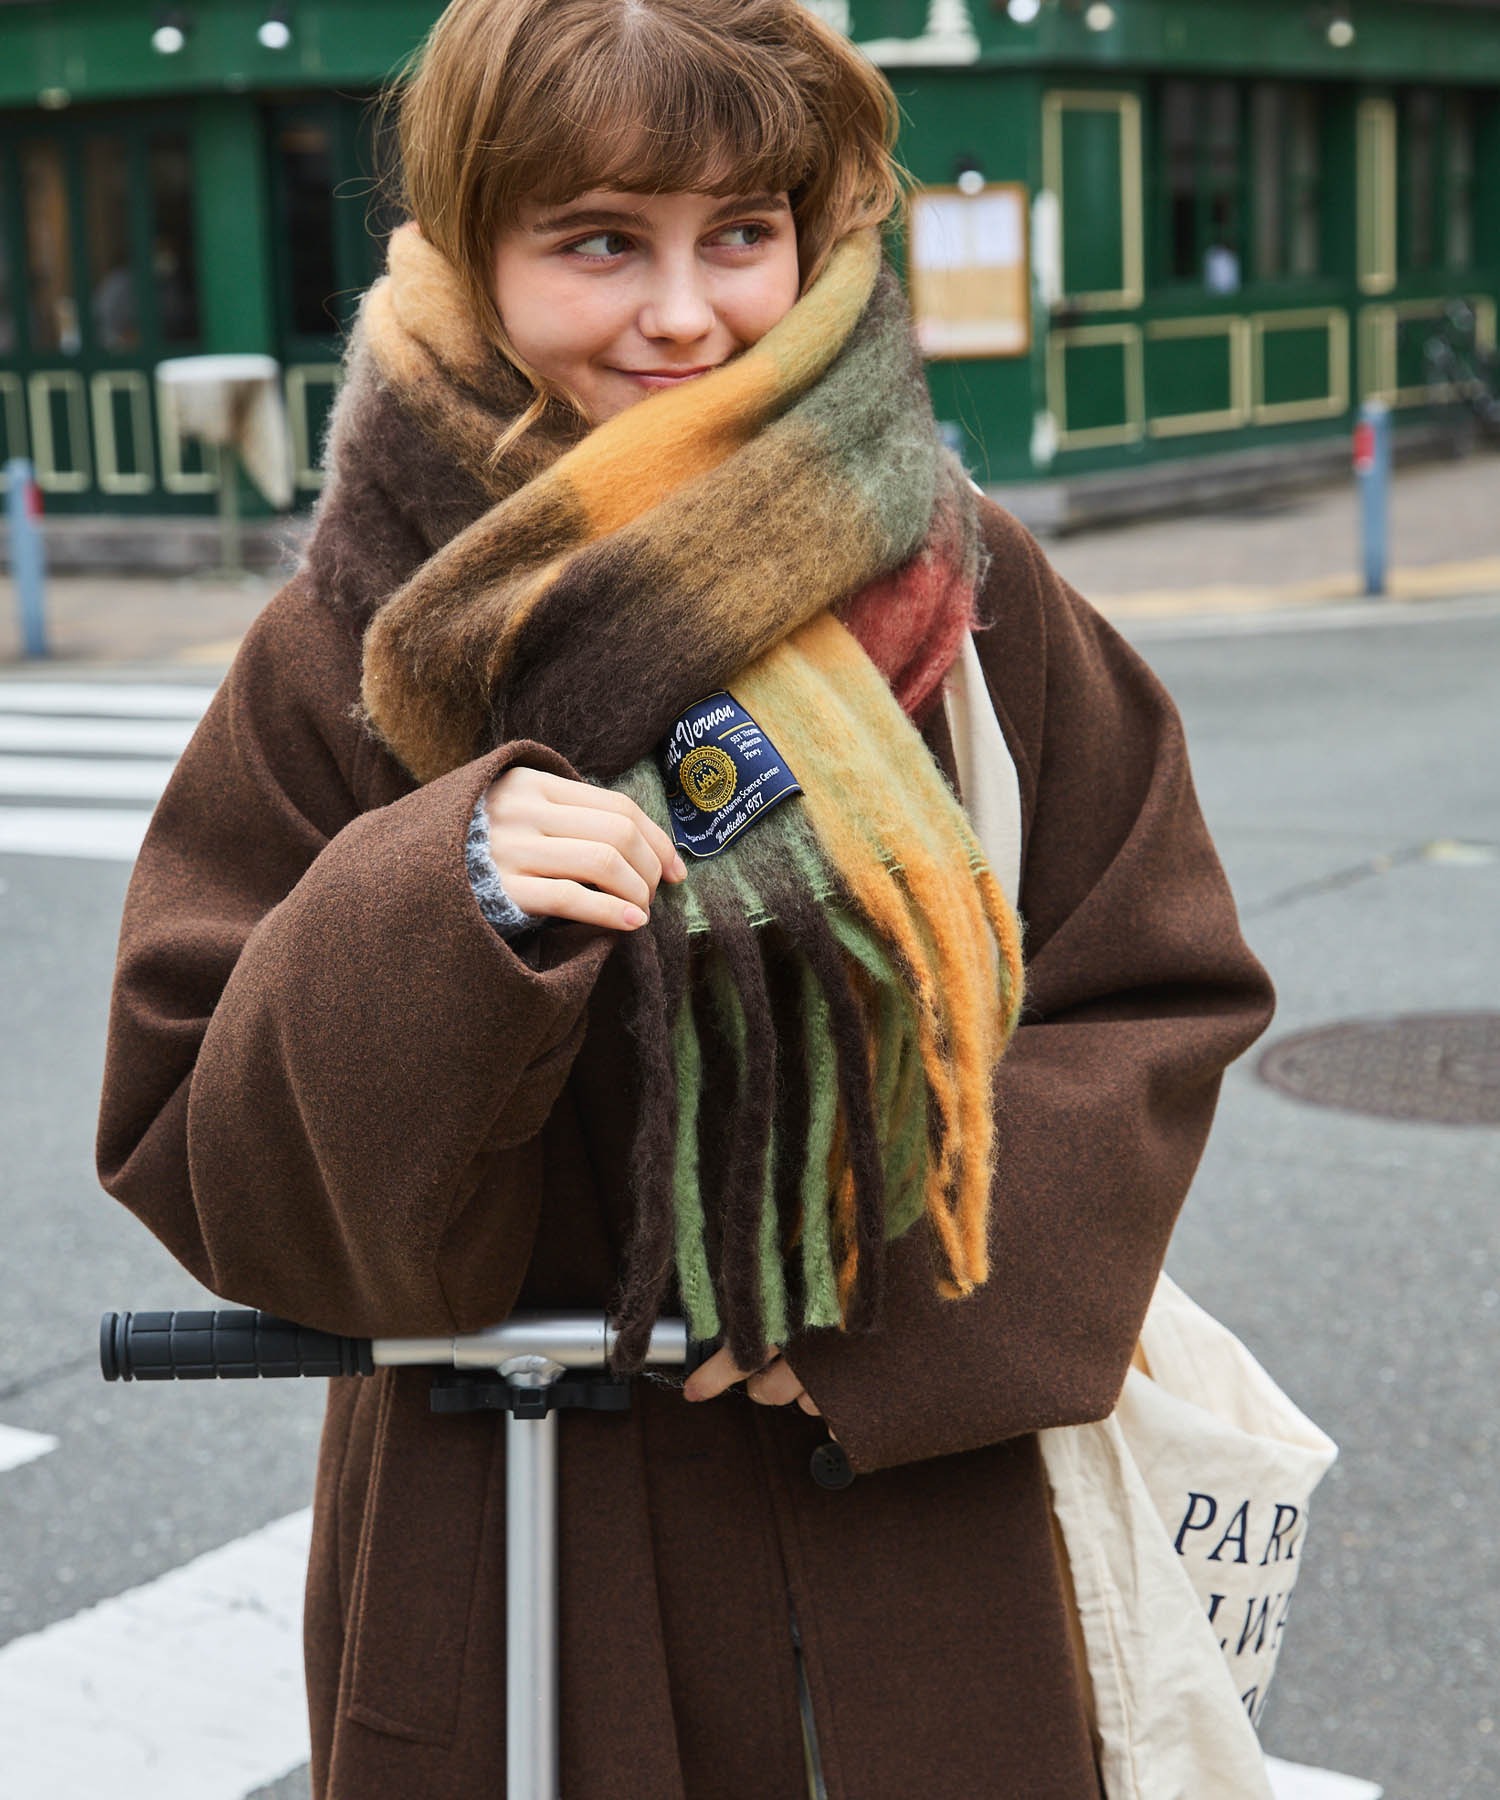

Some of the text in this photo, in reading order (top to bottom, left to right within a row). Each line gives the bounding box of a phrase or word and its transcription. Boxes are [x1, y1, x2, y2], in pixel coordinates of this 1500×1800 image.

[676, 705, 734, 747] Vernon
[730, 732, 743, 744] 931
[739, 778, 762, 799] Science
[760, 766, 780, 782] Center
[745, 791, 765, 816] 1987
